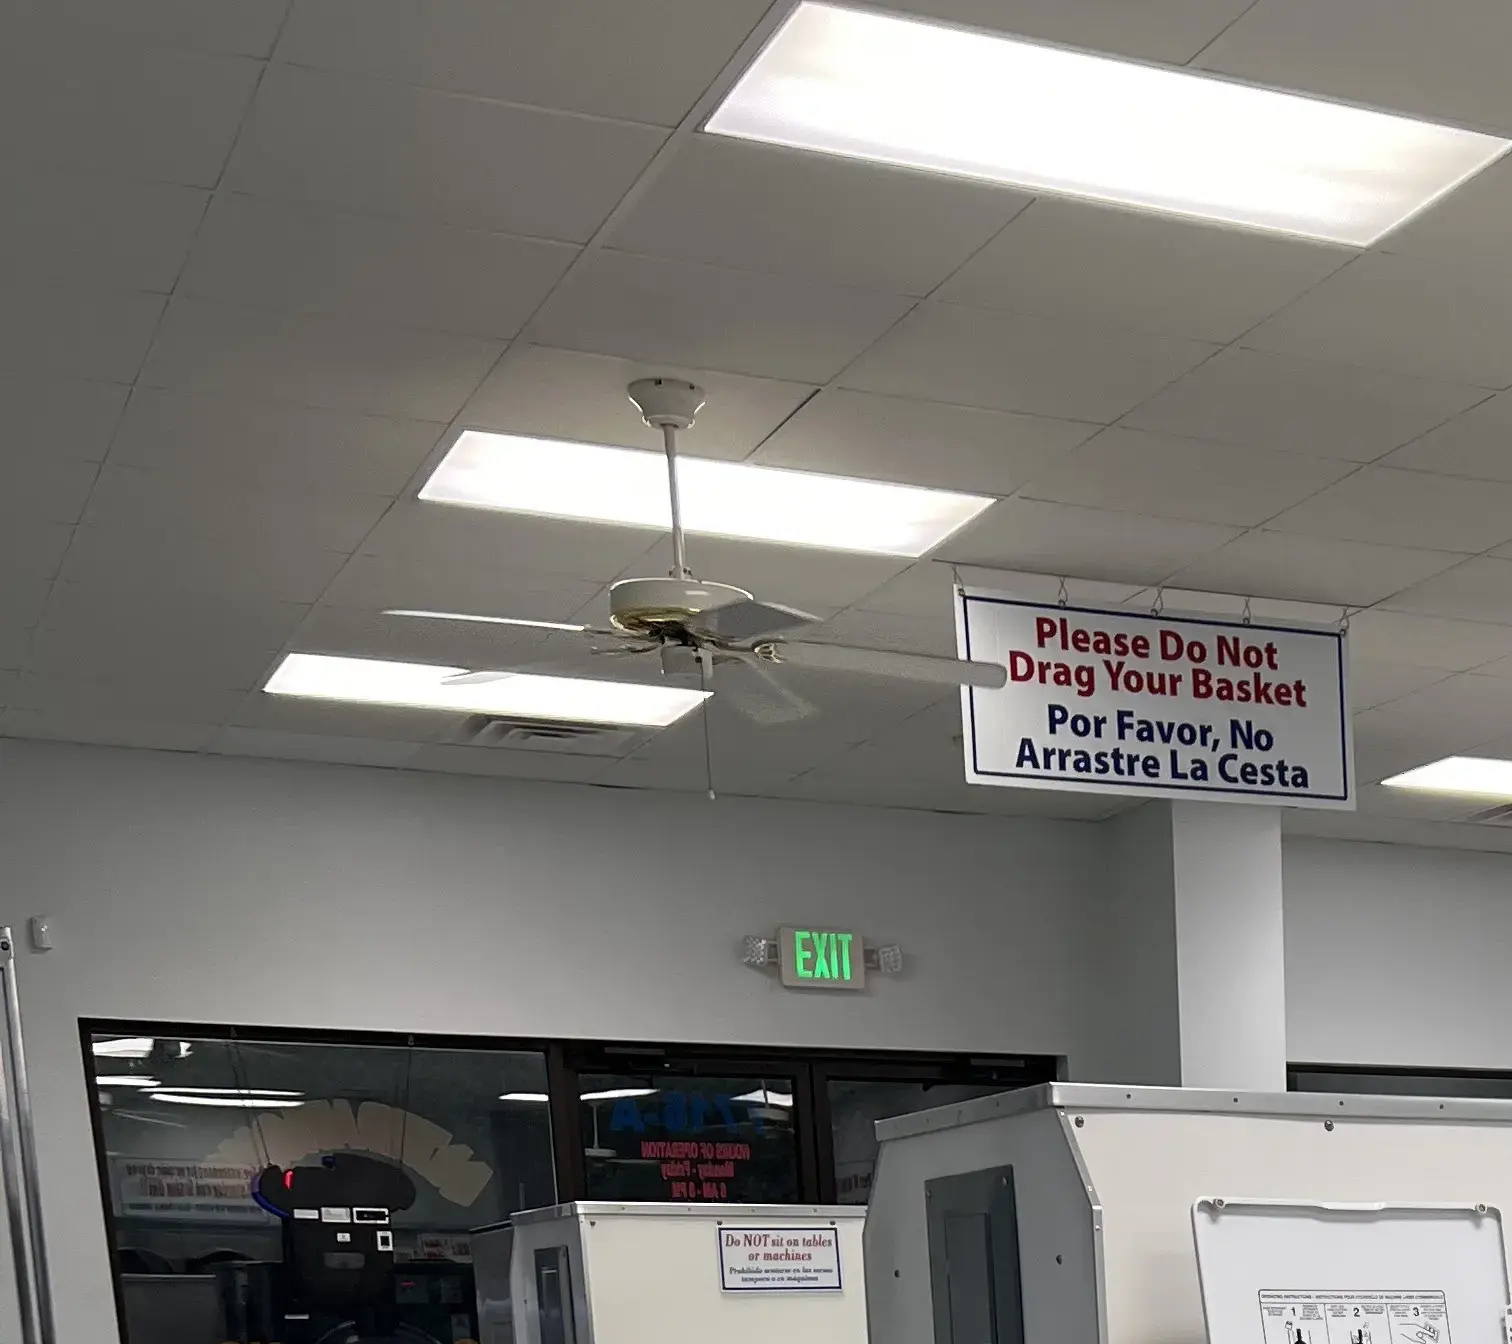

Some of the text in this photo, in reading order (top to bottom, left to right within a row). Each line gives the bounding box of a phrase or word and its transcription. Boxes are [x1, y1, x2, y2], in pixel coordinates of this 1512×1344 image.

[1036, 616, 1279, 671] Please Do Not
[1009, 650, 1308, 708] Drag Your Basket
[1048, 703, 1275, 753] Por Favor, No
[1016, 737, 1309, 789] Arrastre La Cesta
[794, 930, 853, 981] EXIT
[725, 1234, 833, 1247] Do NOT sit on tables
[748, 1248, 813, 1262] or machines
[1291, 1307, 1296, 1316] 1
[1353, 1307, 1360, 1317] 2
[1412, 1307, 1420, 1317] 3
